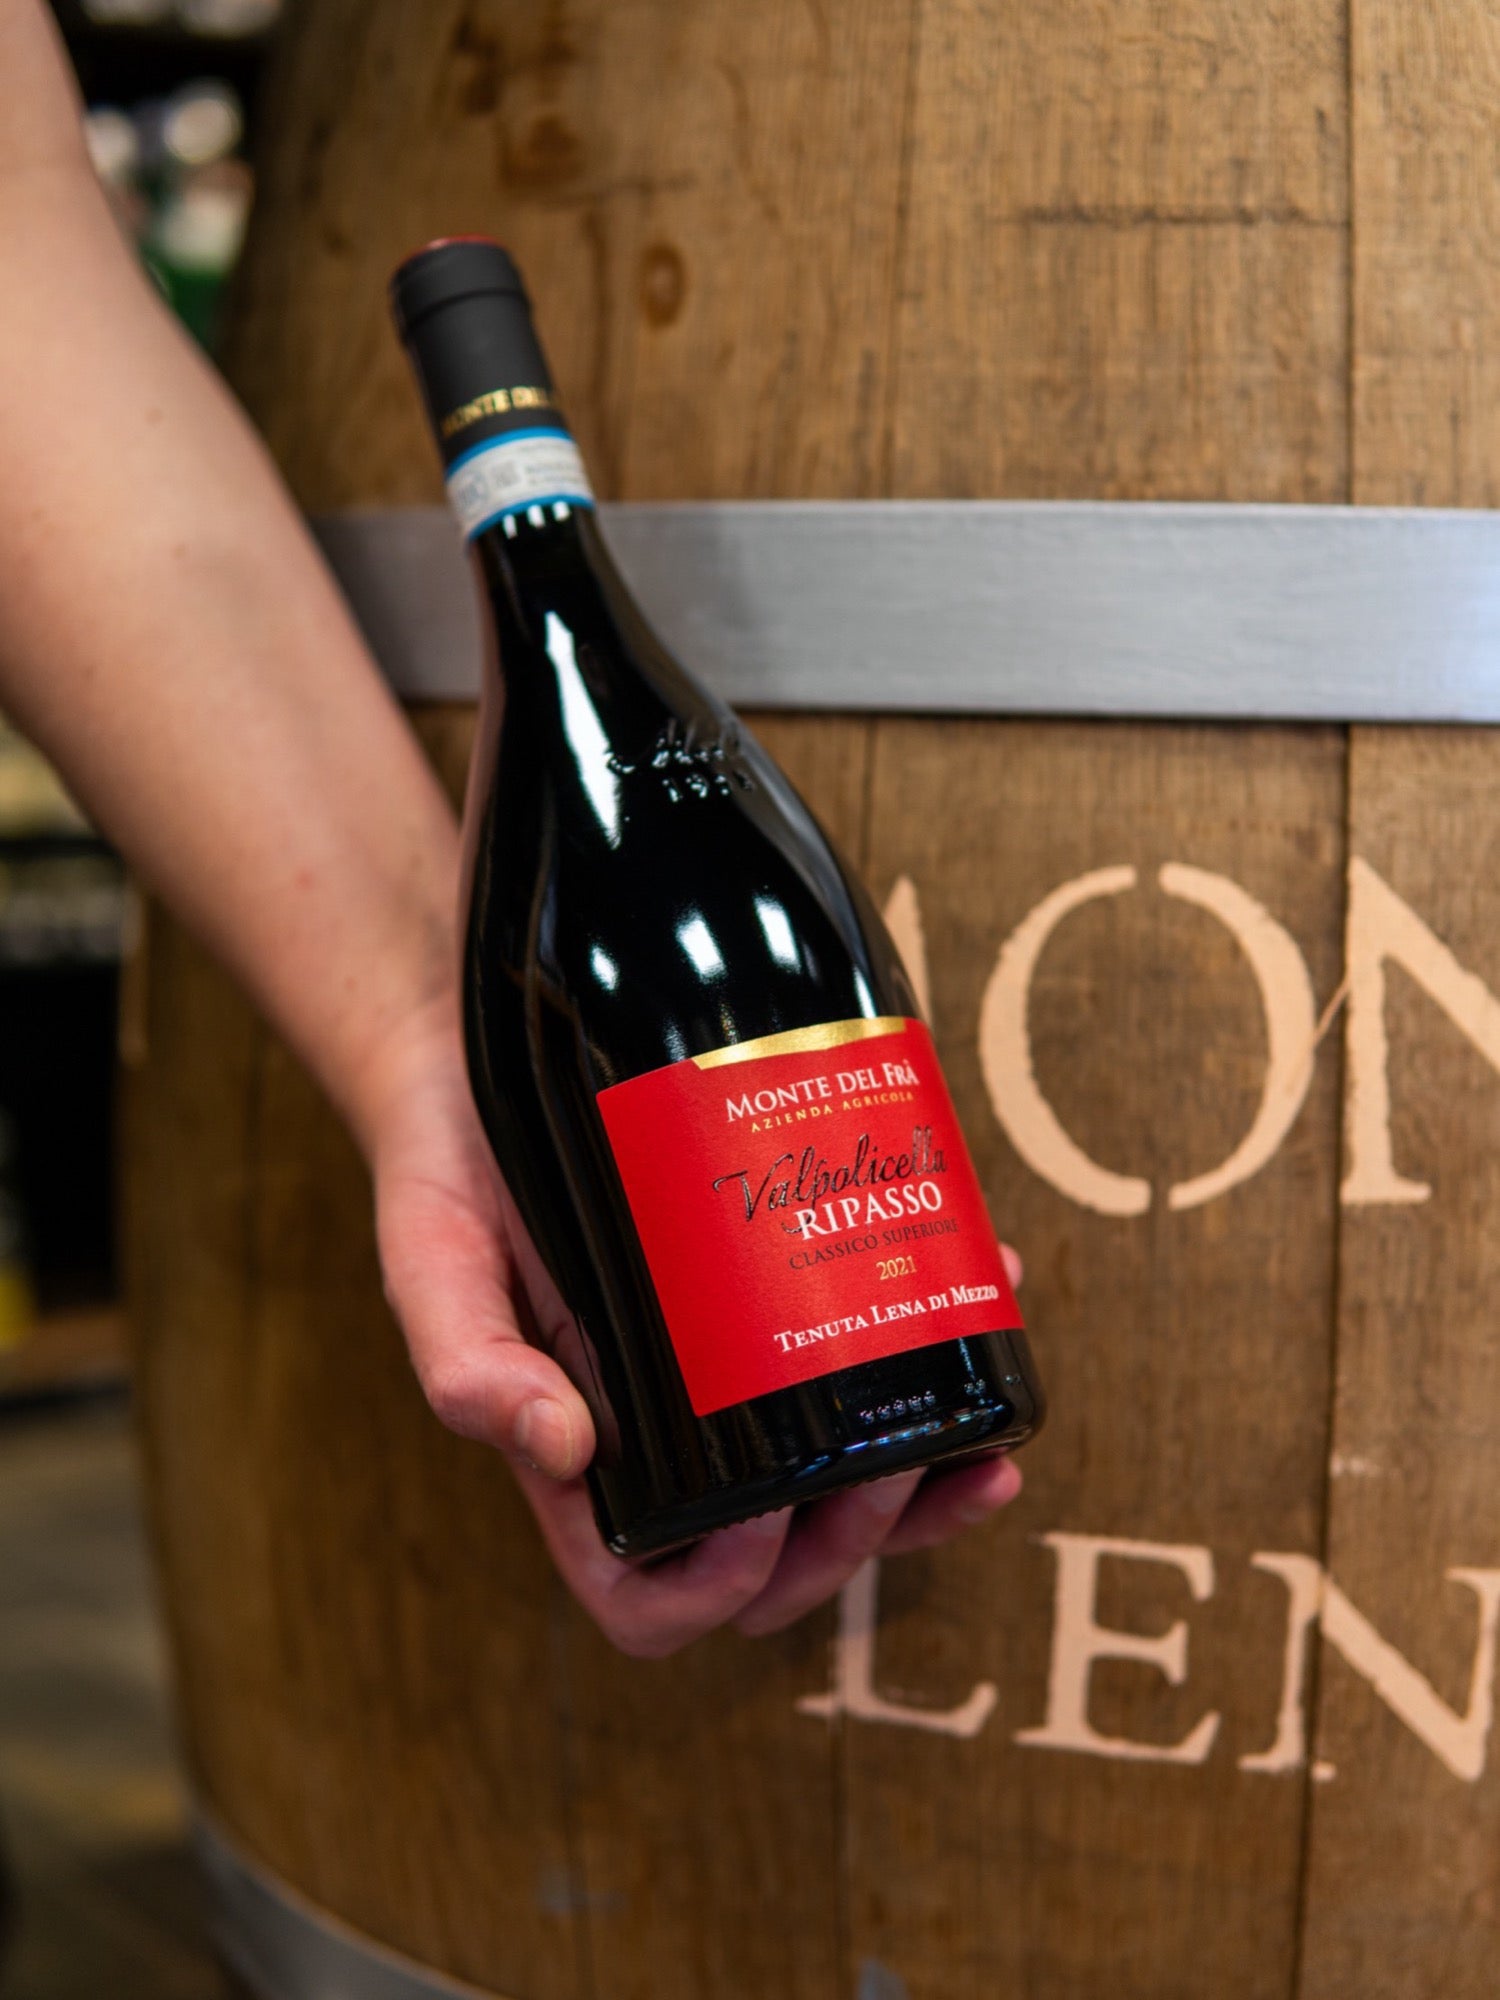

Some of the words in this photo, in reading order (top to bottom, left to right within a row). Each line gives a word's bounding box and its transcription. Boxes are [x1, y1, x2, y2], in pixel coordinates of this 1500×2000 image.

[726, 1077, 832, 1122] MONTE
[836, 1069, 882, 1094] DEL
[751, 1104, 833, 1133] AZIENDA
[842, 1091, 914, 1111] AGRICOLA
[712, 1125, 947, 1234] Valpolicella
[794, 1181, 943, 1241] RIPASSO
[788, 1233, 879, 1270] CLASSICO
[882, 1218, 958, 1246] SUPERIORE
[875, 1255, 917, 1281] 2021
[773, 1315, 869, 1352] TENUTA
[872, 1297, 927, 1325] LENA
[927, 1292, 950, 1310] DI
[949, 1284, 999, 1306] MEZZO
